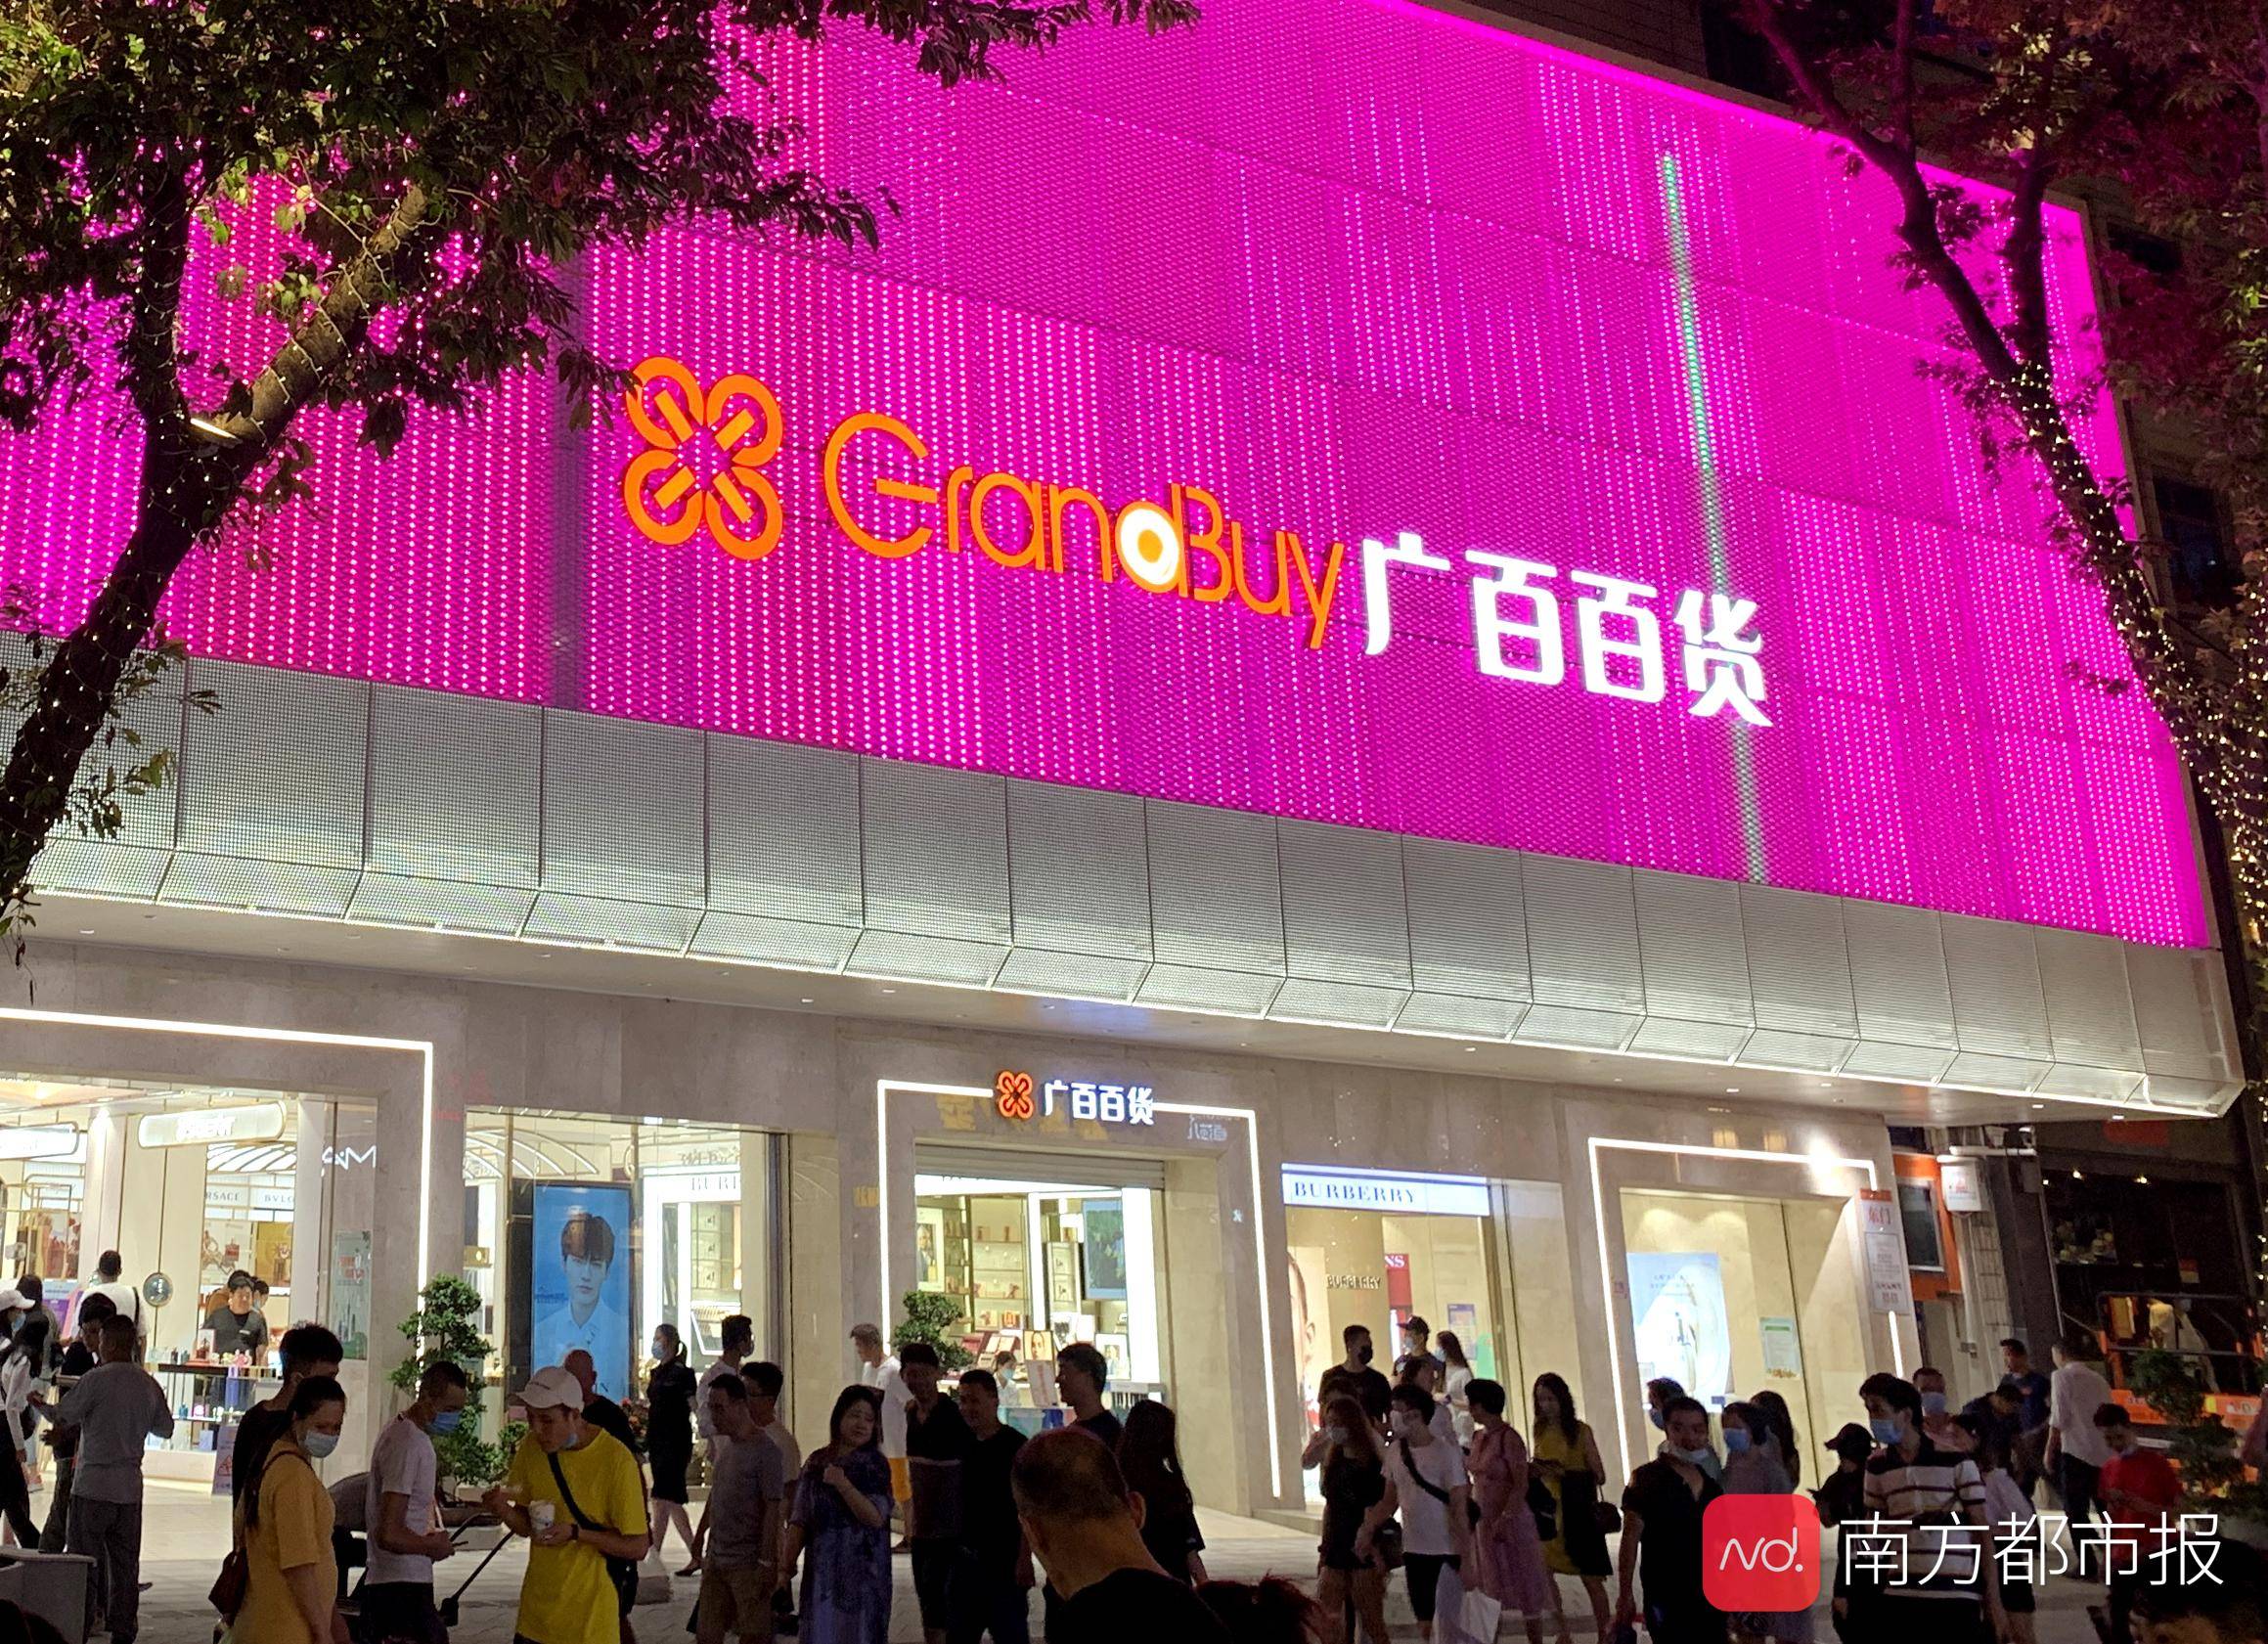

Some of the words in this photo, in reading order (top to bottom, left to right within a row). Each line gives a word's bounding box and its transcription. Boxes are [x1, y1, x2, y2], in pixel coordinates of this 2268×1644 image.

[823, 412, 1345, 649] GrandBuy
[1362, 531, 1773, 728] 广百百货
[1044, 1080, 1155, 1126] 广百百货
[1294, 1181, 1417, 1204] BURBERRY
